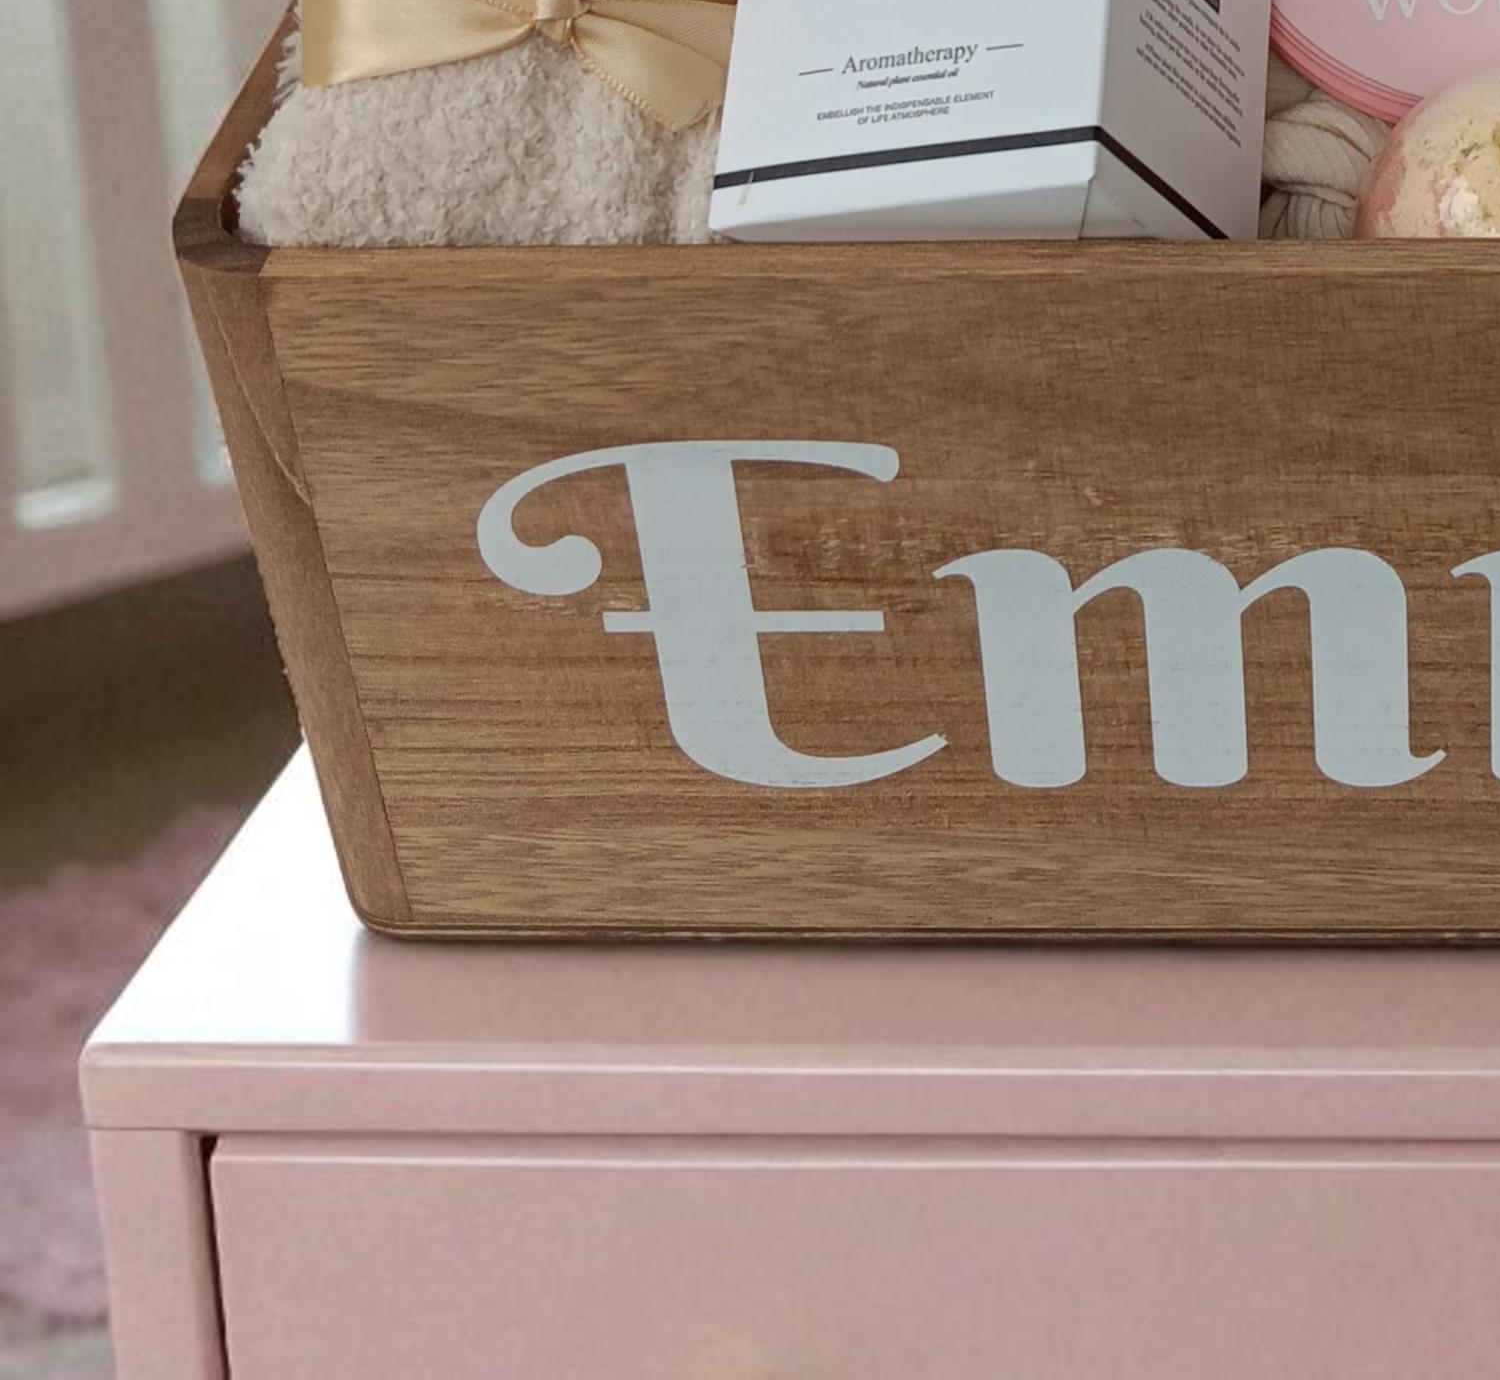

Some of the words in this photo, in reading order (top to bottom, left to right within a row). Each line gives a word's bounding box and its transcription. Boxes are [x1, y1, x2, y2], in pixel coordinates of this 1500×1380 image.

[841, 44, 979, 74] Aromatherapy
[856, 76, 889, 90] Natural
[887, 74, 912, 89] plant
[911, 69, 948, 83] essential
[947, 67, 960, 78] oil
[817, 106, 864, 121] EMBELLISH
[866, 104, 882, 114] THE
[884, 95, 951, 111] INDISPENSABLE
[953, 90, 995, 103] ELEMENT
[857, 115, 870, 126] OF
[871, 113, 889, 123] LIFE
[890, 105, 950, 121] ATMOSPHERE
